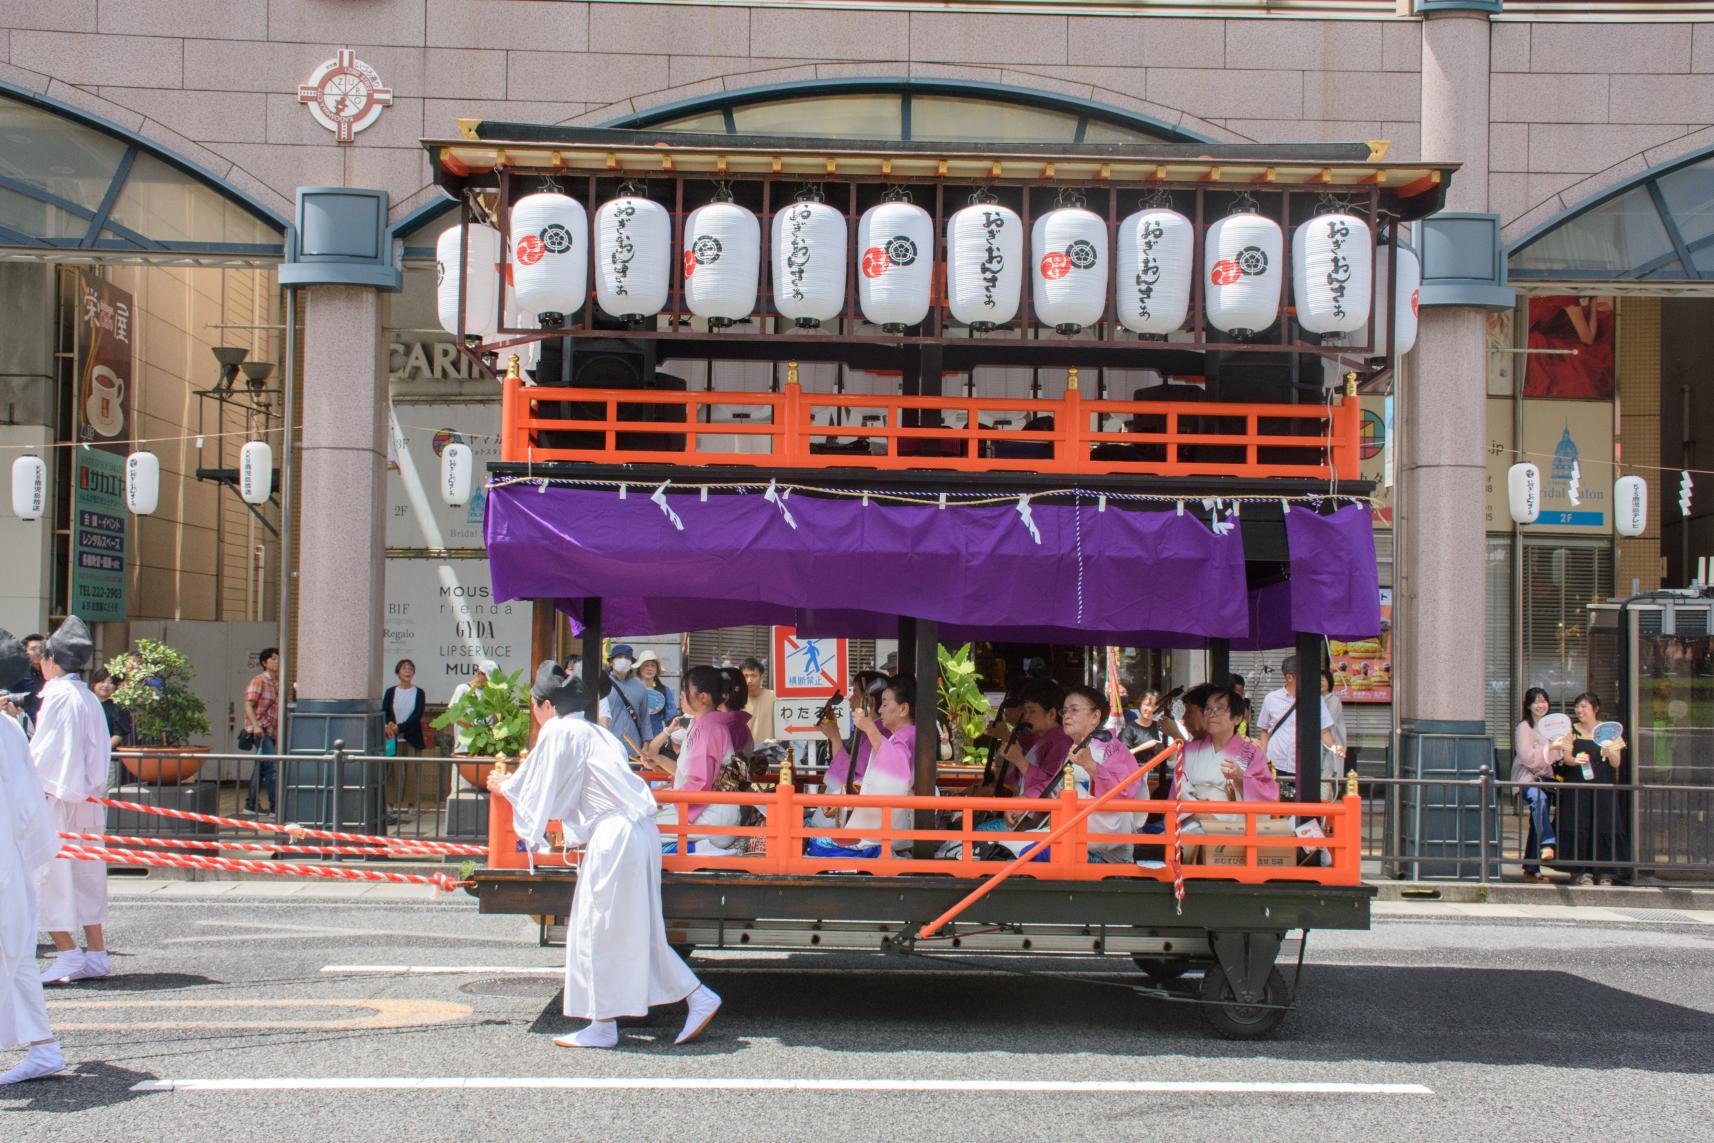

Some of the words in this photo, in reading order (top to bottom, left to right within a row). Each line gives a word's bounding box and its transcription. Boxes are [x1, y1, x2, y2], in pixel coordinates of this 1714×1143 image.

[980, 211, 1005, 310] おぎおんさぁ
[1134, 219, 1164, 321] おぎおんさぁ
[1326, 219, 1350, 320] おぎおんさぁ
[394, 506, 408, 517] 2F
[1560, 513, 1573, 524] 2F
[82, 532, 120, 550] レンタルスペース
[439, 586, 493, 598] MOUS
[439, 602, 513, 615] rienda
[383, 629, 415, 641] Regalo
[456, 621, 495, 640] GYDA
[789, 675, 822, 686] 横断禁止
